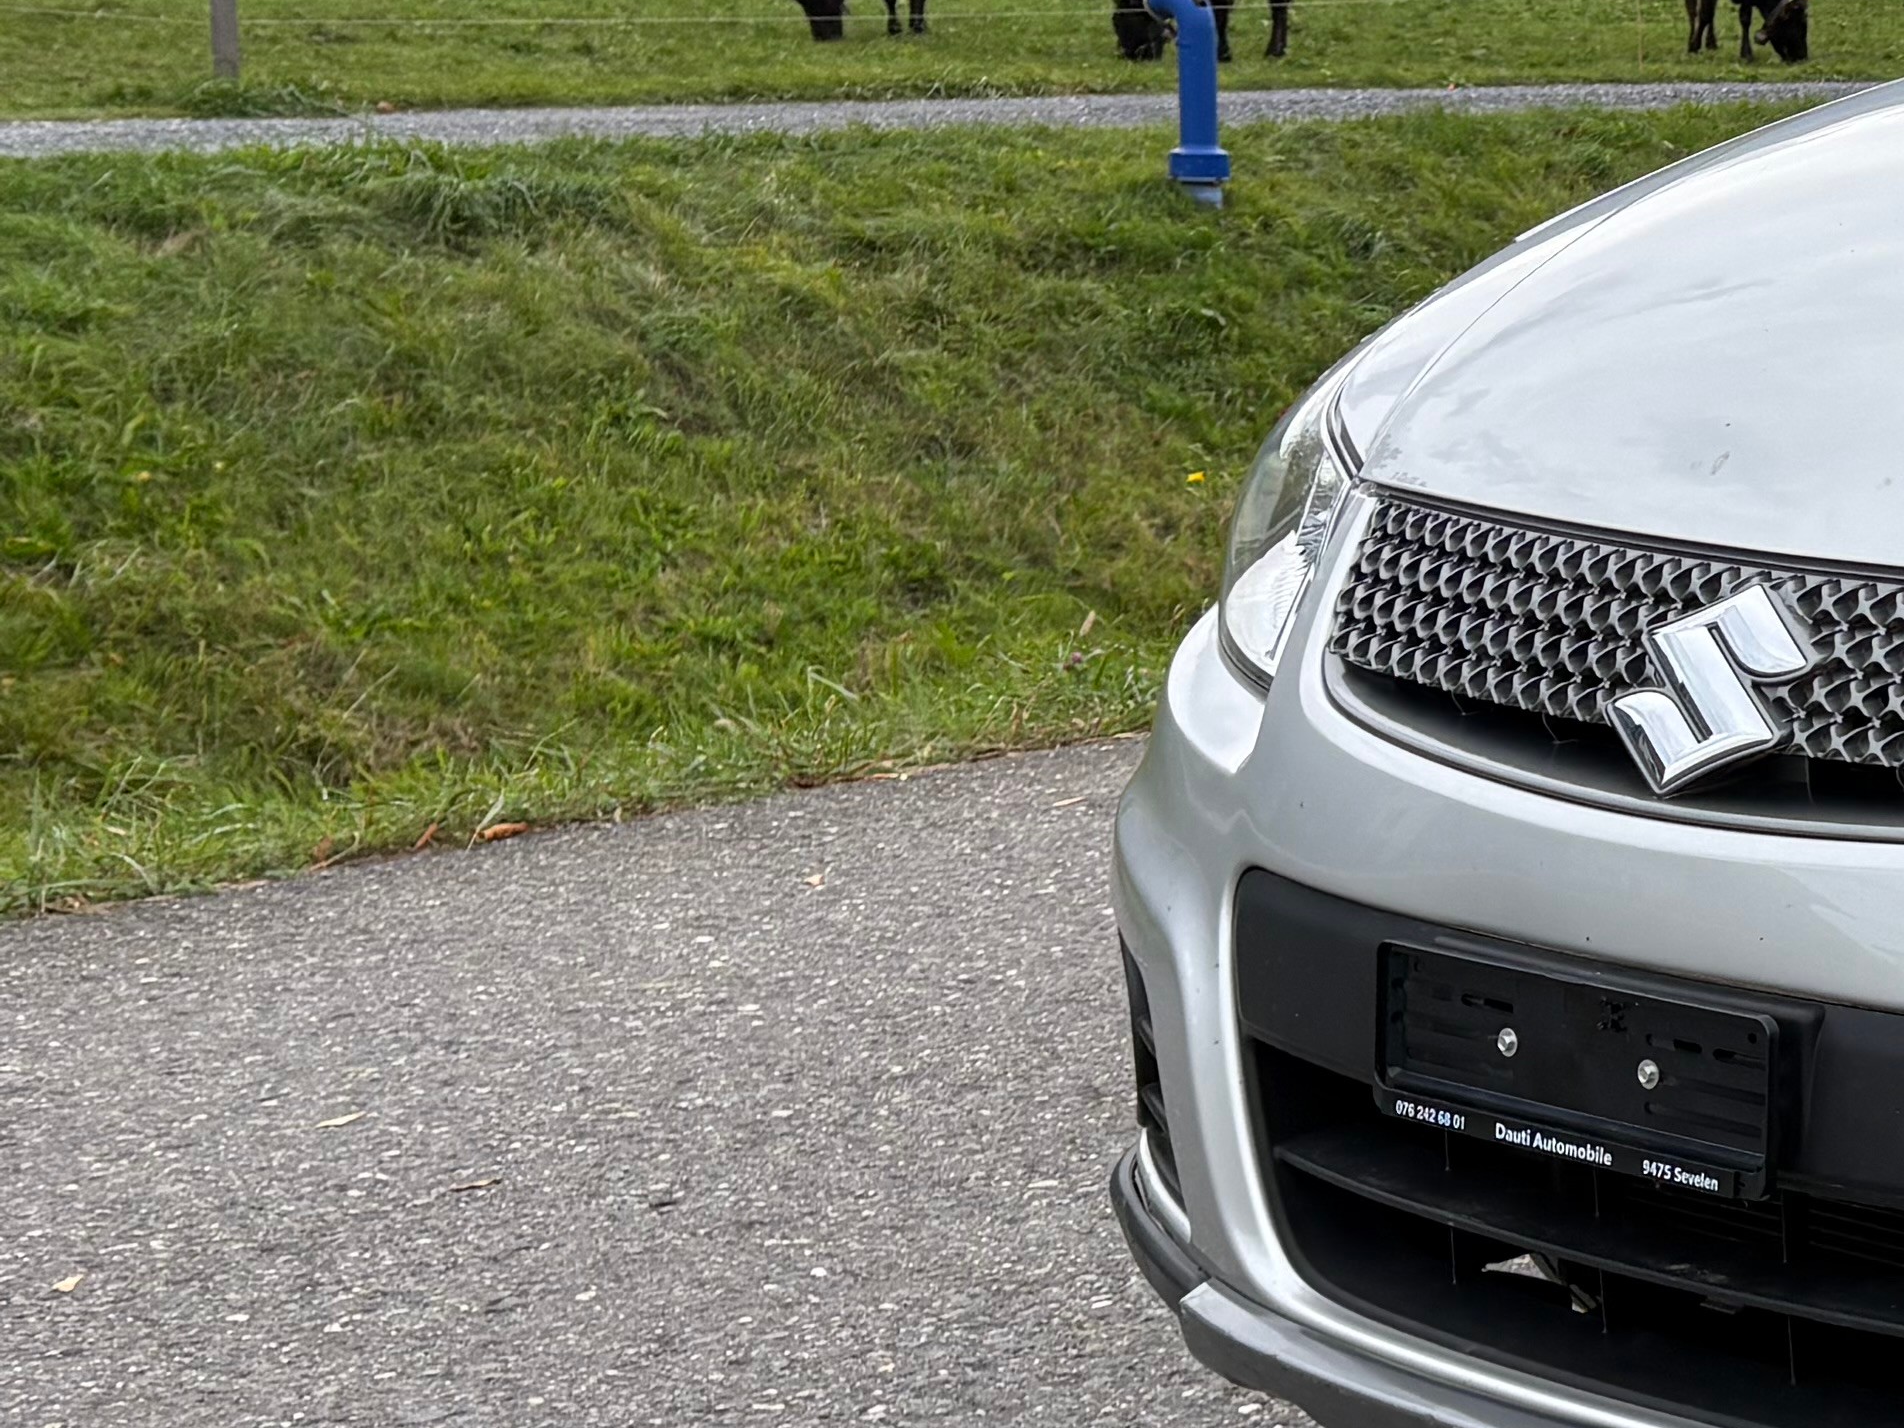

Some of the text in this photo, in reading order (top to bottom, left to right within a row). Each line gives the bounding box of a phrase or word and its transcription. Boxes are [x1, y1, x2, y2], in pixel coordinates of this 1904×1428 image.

[1395, 1099, 1466, 1131] 076 242 68 01
[1495, 1122, 1613, 1166] Dauti Automobile
[1642, 1159, 1719, 1192] 9475 Sevelen
